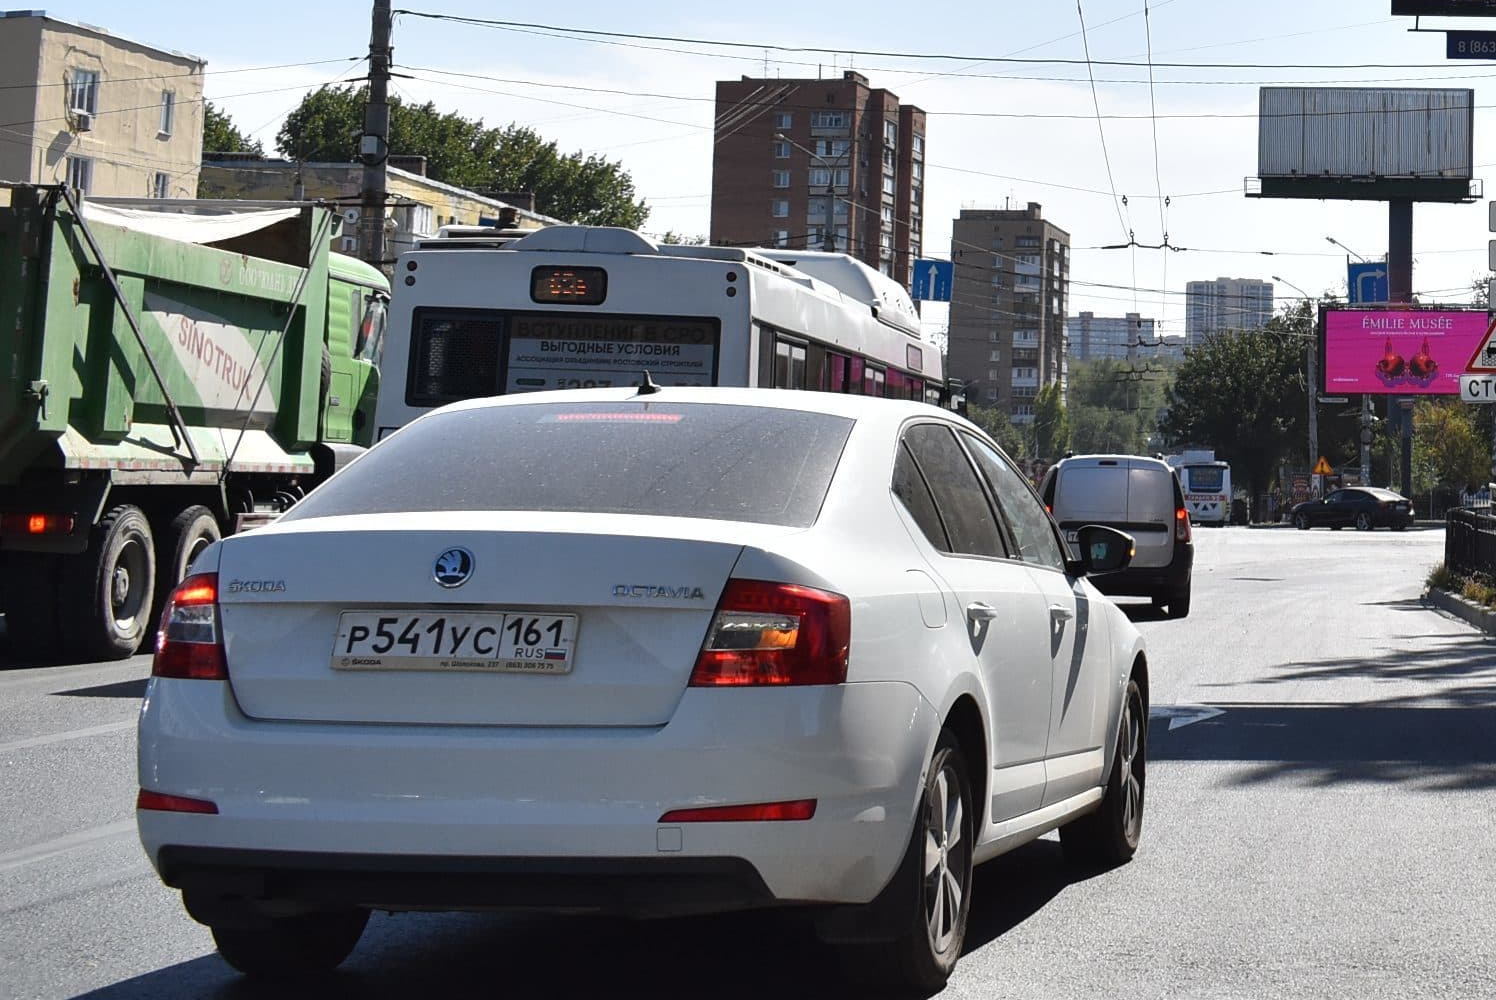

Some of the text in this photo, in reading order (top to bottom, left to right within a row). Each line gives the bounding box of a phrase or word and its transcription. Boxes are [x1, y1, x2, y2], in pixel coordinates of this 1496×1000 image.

[1458, 41, 1466, 53] 8
[1362, 315, 1453, 329] ÉMILIE MUSÉE
[541, 340, 681, 356] ВЫГОДНЫЕ УСЛОВИЯ
[178, 317, 253, 401] SINOTRUK
[229, 579, 287, 593] ŠKODA
[612, 585, 705, 601] OCTAVIA
[506, 618, 565, 647] 161
[514, 648, 544, 659] RUS
